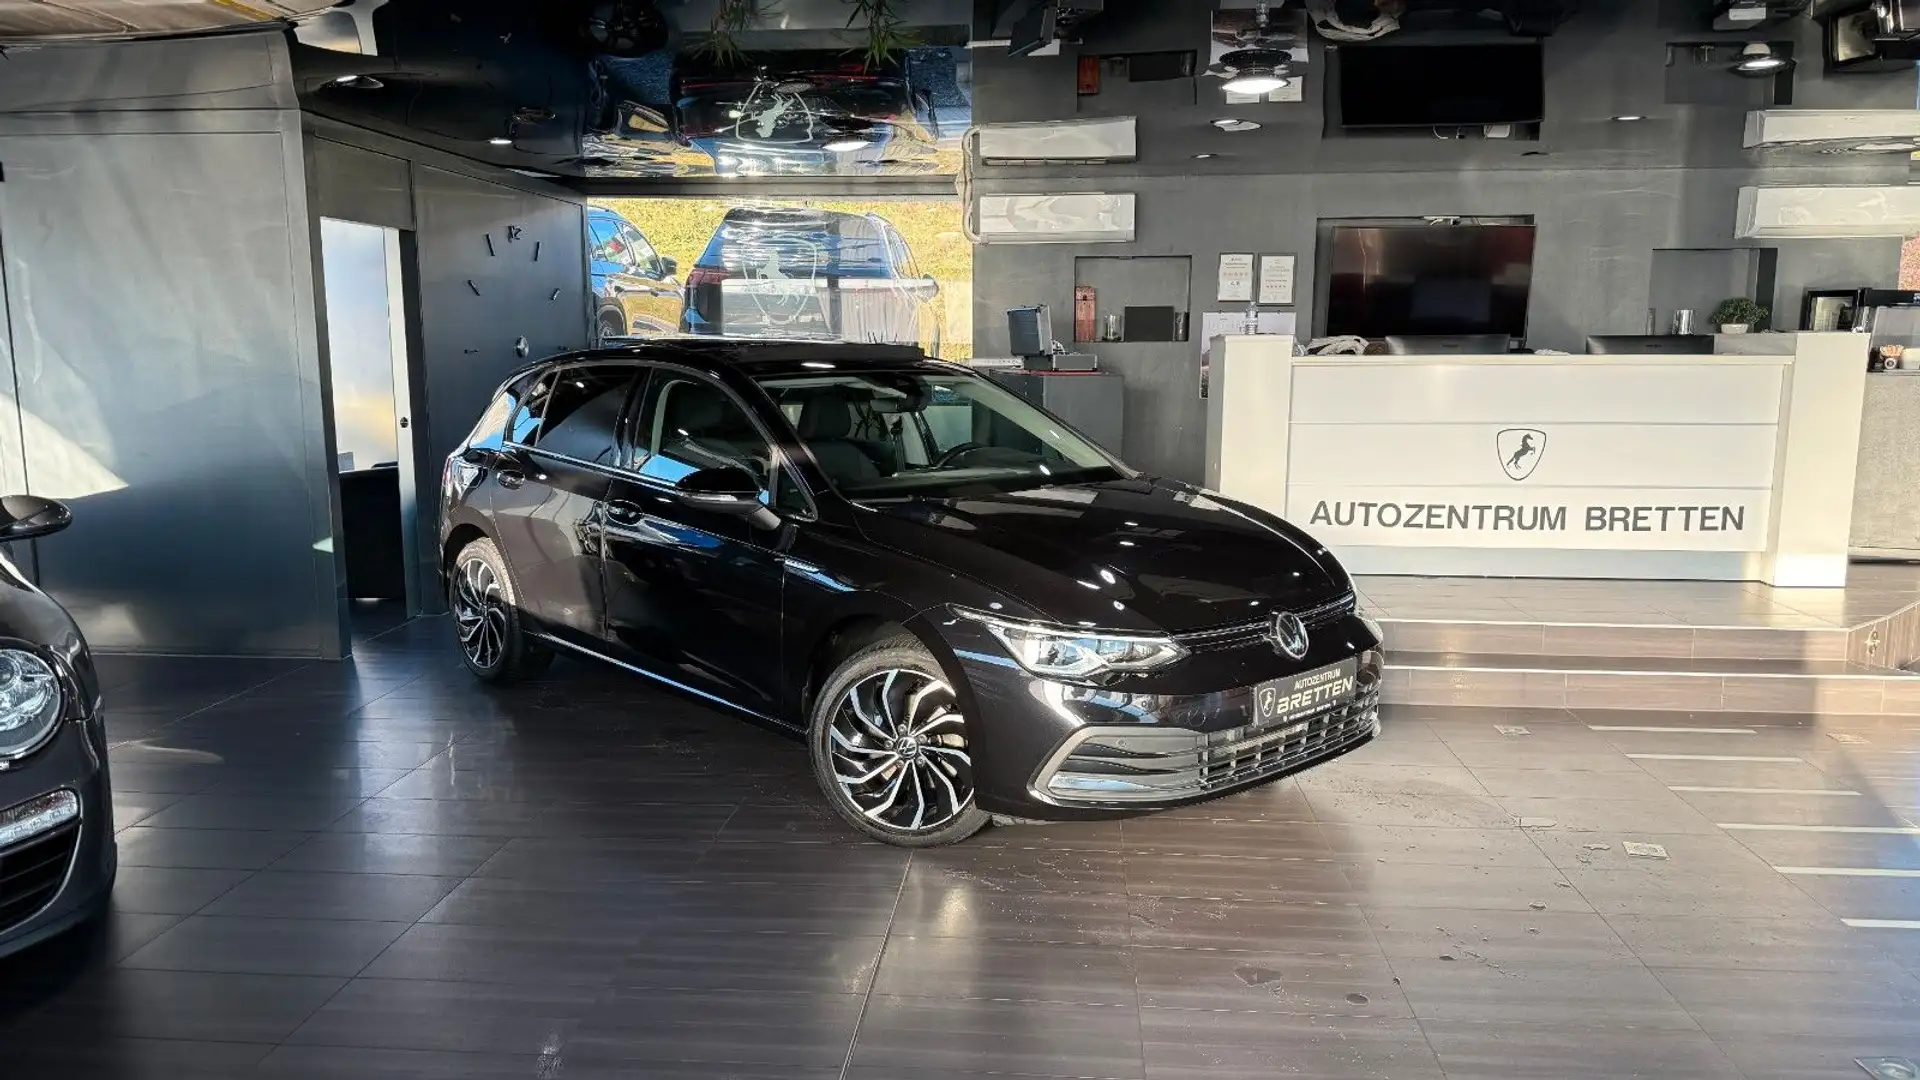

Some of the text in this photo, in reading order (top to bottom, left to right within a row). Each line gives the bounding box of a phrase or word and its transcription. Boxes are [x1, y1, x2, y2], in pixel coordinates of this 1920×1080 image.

[1309, 500, 1745, 532] AUTOZENTRUM BRETTEN
[1277, 675, 1354, 715] BRETTEN
[1294, 668, 1341, 690] AUTOZENTRUM
